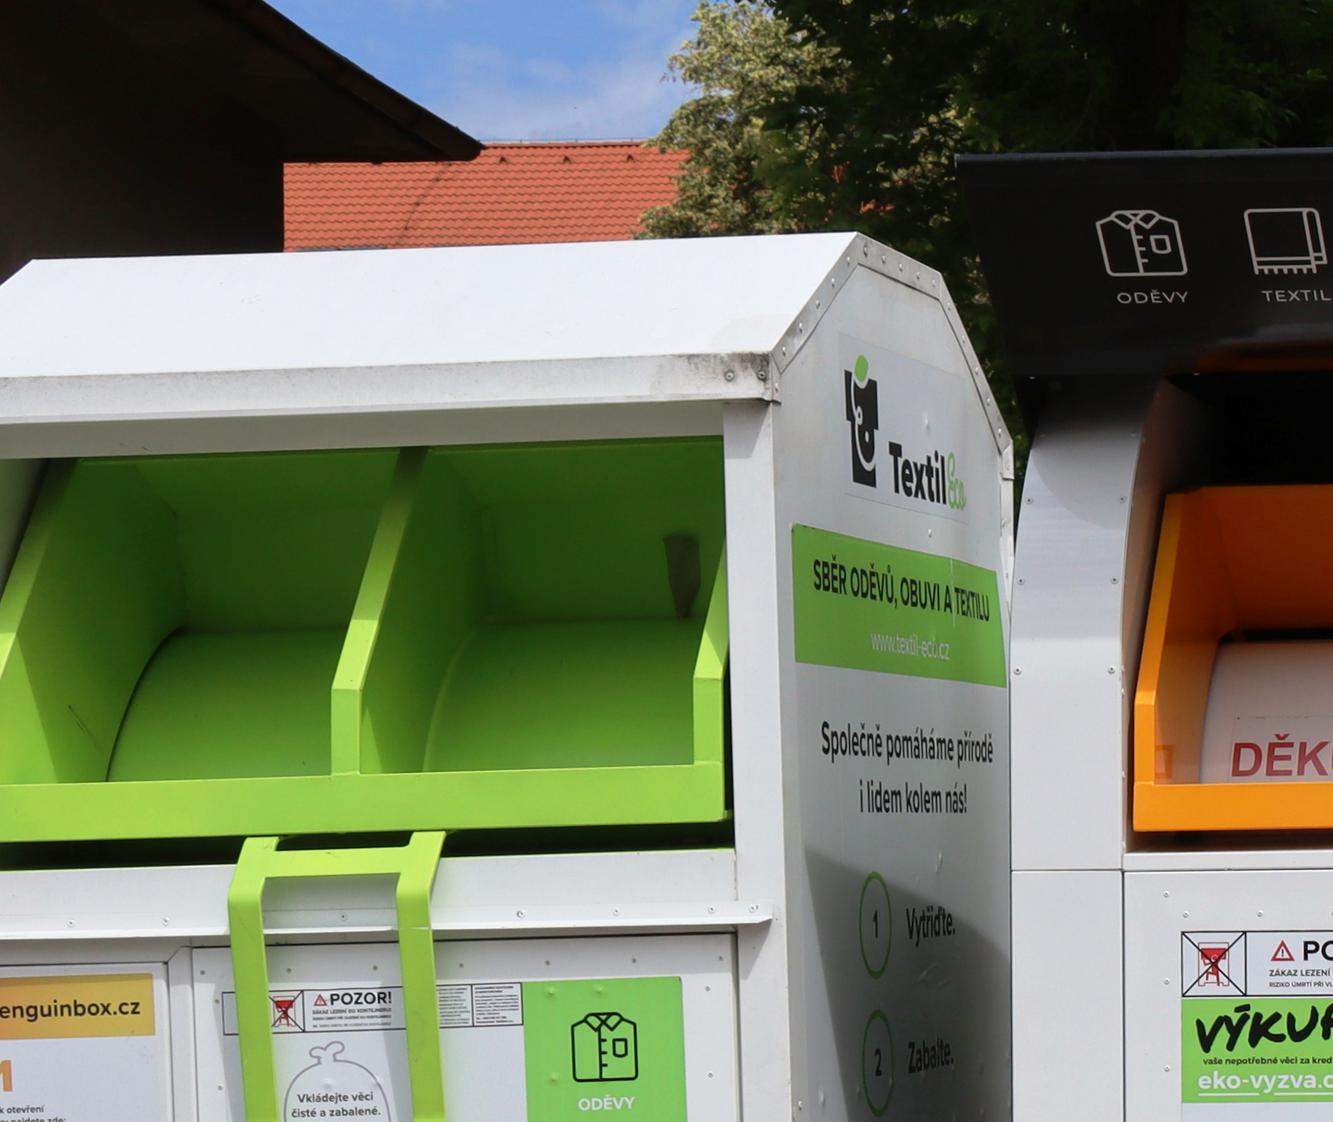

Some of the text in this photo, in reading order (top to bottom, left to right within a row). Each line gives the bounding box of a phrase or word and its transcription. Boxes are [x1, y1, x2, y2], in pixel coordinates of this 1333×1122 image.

[1117, 289, 1189, 305] ODĚVY
[1261, 289, 1332, 303] TEXTIL
[813, 554, 991, 623] SBĚR ODĚVŮ, OBUVI A TEXTILU
[821, 720, 994, 770] Společně pomáháme přírodě
[859, 780, 968, 816] i lidem kolem nás!
[872, 908, 957, 952] 1 Vytřiďte.
[330, 991, 392, 1005] POZOR!
[874, 1039, 955, 1076] 2 Zabalte.
[578, 1095, 635, 1111] ODĚVY
